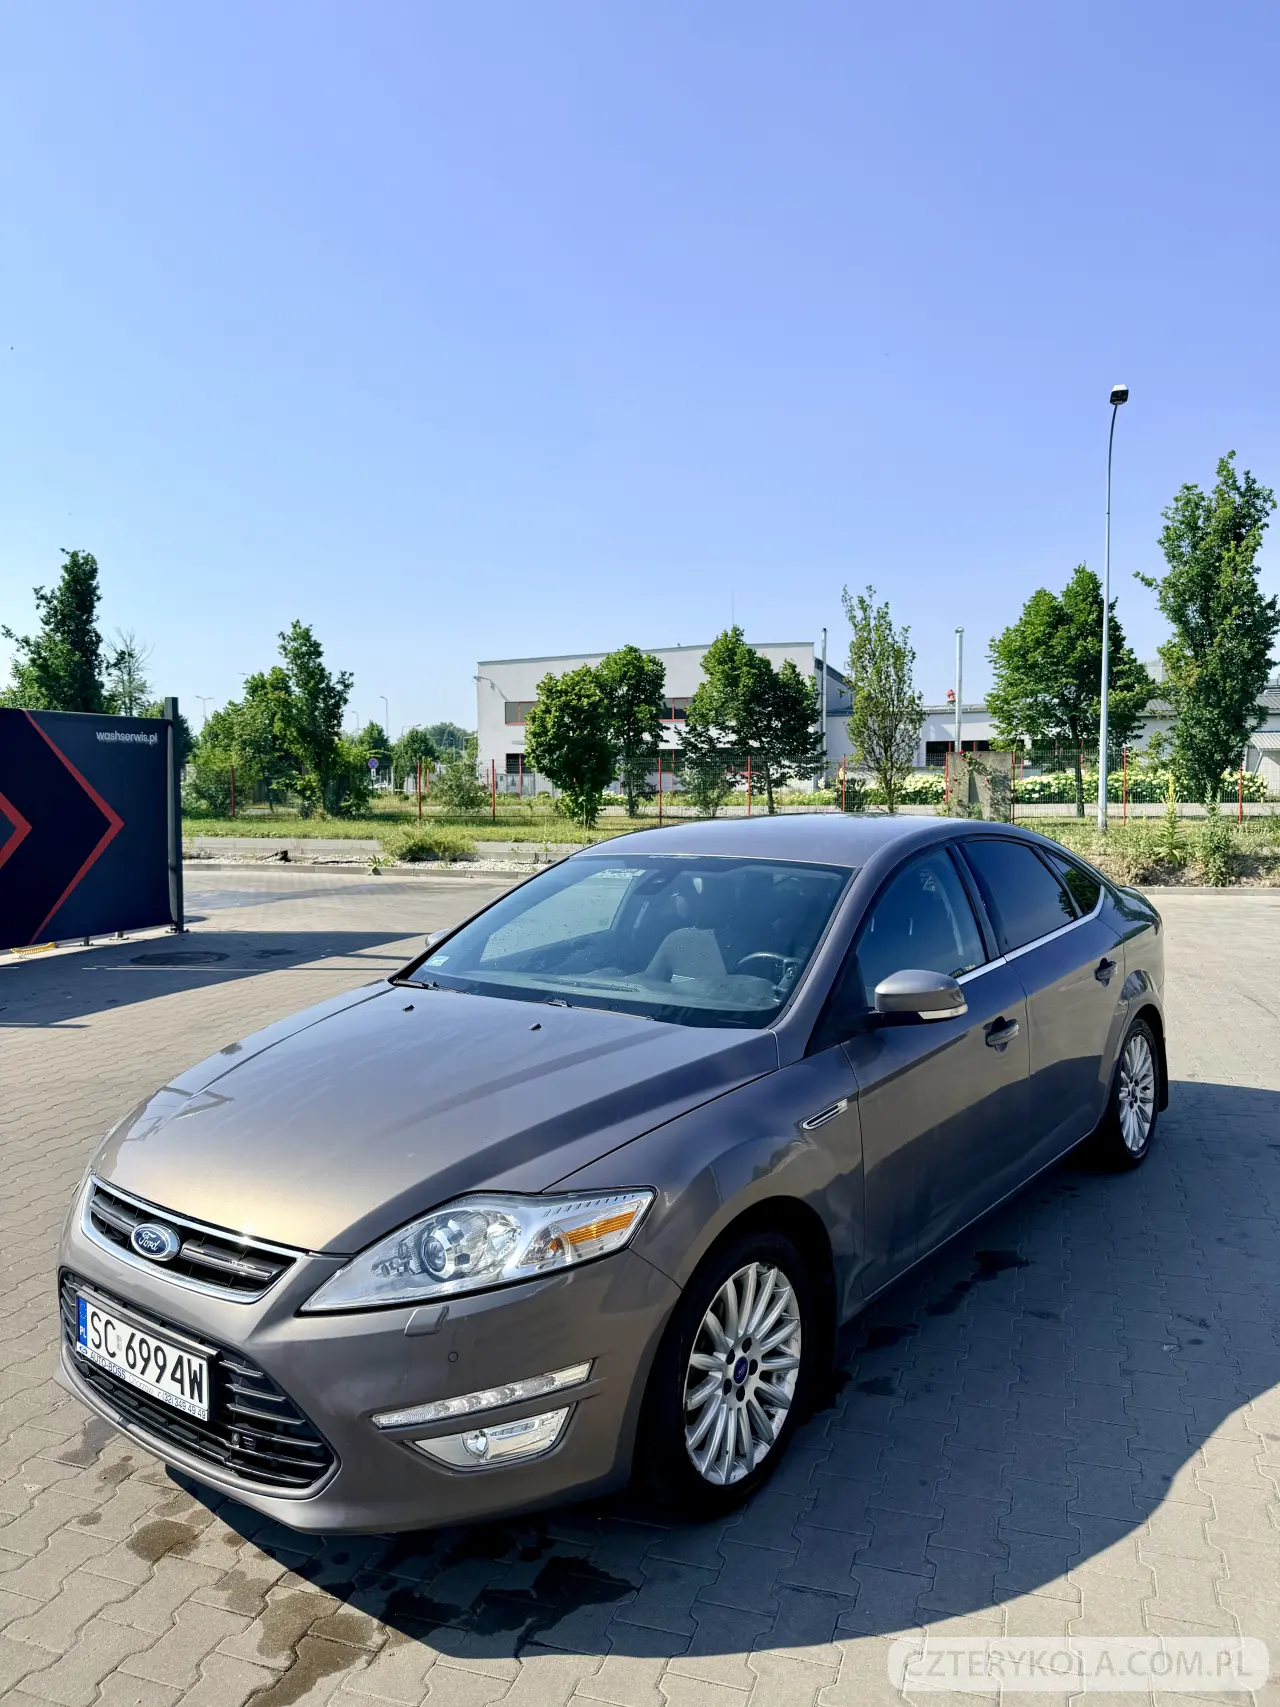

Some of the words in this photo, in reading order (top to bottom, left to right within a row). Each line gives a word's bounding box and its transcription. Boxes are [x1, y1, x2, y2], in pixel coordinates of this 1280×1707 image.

[96, 730, 158, 746] washserwis.pl
[138, 1230, 161, 1251] Ford
[80, 1325, 87, 1338] PL
[91, 1310, 117, 1358] SC
[126, 1332, 204, 1404] 6994W
